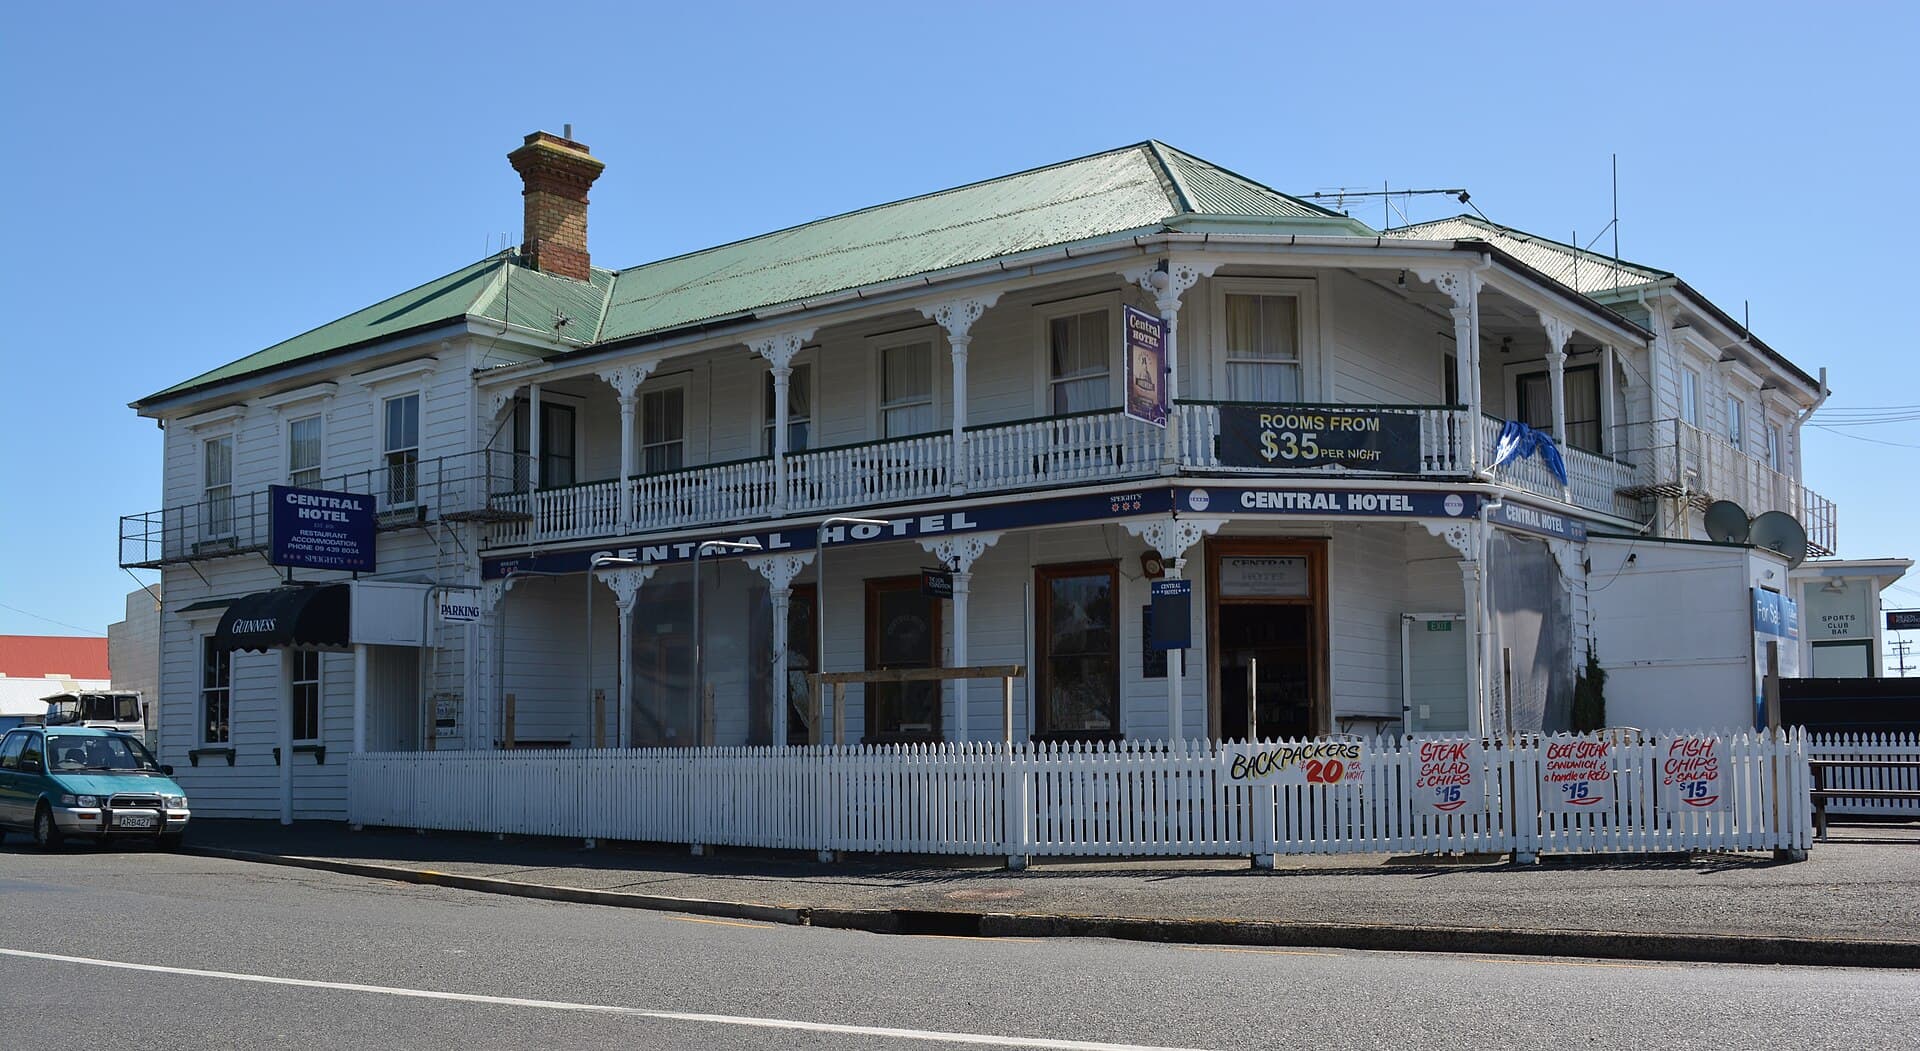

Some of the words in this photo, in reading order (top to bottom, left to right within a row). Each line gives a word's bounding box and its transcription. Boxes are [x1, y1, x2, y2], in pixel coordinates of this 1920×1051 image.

[1130, 314, 1160, 338] Central
[1132, 329, 1158, 347] HOTEL
[1260, 414, 1325, 430] ROOMS
[1330, 417, 1380, 431] FROM
[1260, 429, 1319, 462] $35
[1320, 449, 1344, 458] PER
[1348, 449, 1381, 461] NIGHT
[286, 493, 362, 511] CENTRAL
[1241, 491, 1341, 511] CENTRAL
[1347, 494, 1414, 512] HOTEL
[298, 507, 349, 522] HOTEL
[1506, 504, 1540, 527] CENTRAL
[1541, 512, 1564, 533] HOTEL
[299, 529, 348, 540] RESTAURANT
[819, 511, 977, 544] HOTEL
[287, 543, 313, 552] PHONE
[341, 547, 359, 555] 8034
[291, 536, 357, 547] ACCOMMODATION
[441, 604, 480, 617] PARKING
[1757, 600, 1768, 622] For
[1769, 603, 1781, 625] Sal
[232, 618, 277, 634] GUINNESS
[1420, 742, 1471, 762] STEAK
[1575, 741, 1610, 759] STEAK
[1230, 744, 1360, 780] BACKPACKERS
[1347, 762, 1361, 770] PER
[1421, 761, 1470, 777] SALAD
[1546, 760, 1597, 771] SANDWICH
[1664, 757, 1718, 775] CHIPS
[1300, 759, 1343, 783] $20
[1344, 770, 1365, 781] NIGHT
[1587, 770, 1610, 781] RED
[1675, 772, 1718, 782] SALAD
[1426, 773, 1471, 787] CHIPS
[1435, 785, 1461, 802] $15
[1561, 781, 1589, 799] $15
[1679, 780, 1708, 798] $15
